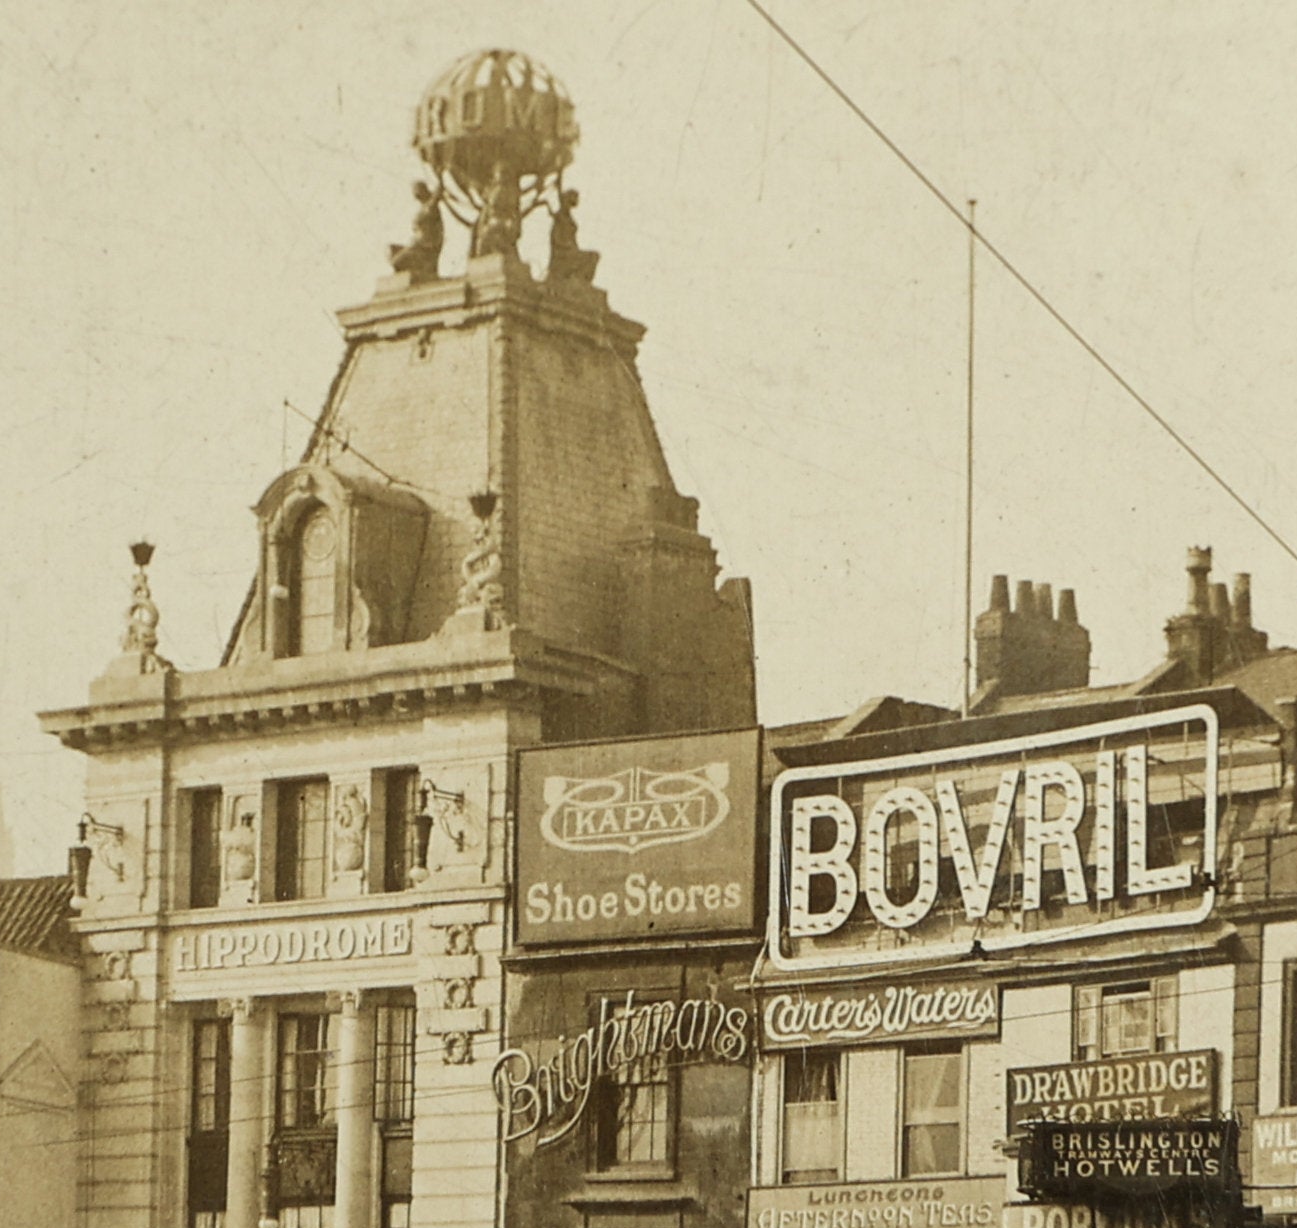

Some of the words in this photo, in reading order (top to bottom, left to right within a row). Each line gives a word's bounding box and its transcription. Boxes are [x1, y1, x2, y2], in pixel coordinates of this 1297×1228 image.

[573, 801, 692, 837] KAPAX
[789, 744, 1192, 938] BOVRIL
[525, 881, 619, 926] Shoe
[623, 871, 742, 917] Stores
[176, 916, 413, 973] HIPPODROME
[764, 990, 883, 1043] Carter's
[490, 989, 749, 1147] Brightmans
[1012, 1055, 1208, 1106] DRAWBRIDGE
[1052, 1131, 1222, 1151] BRISLINGTON
[1058, 1149, 1144, 1161] TRAMWAYS
[1149, 1148, 1210, 1159] CENTRE
[1054, 1158, 1220, 1178] HOTWELLS
